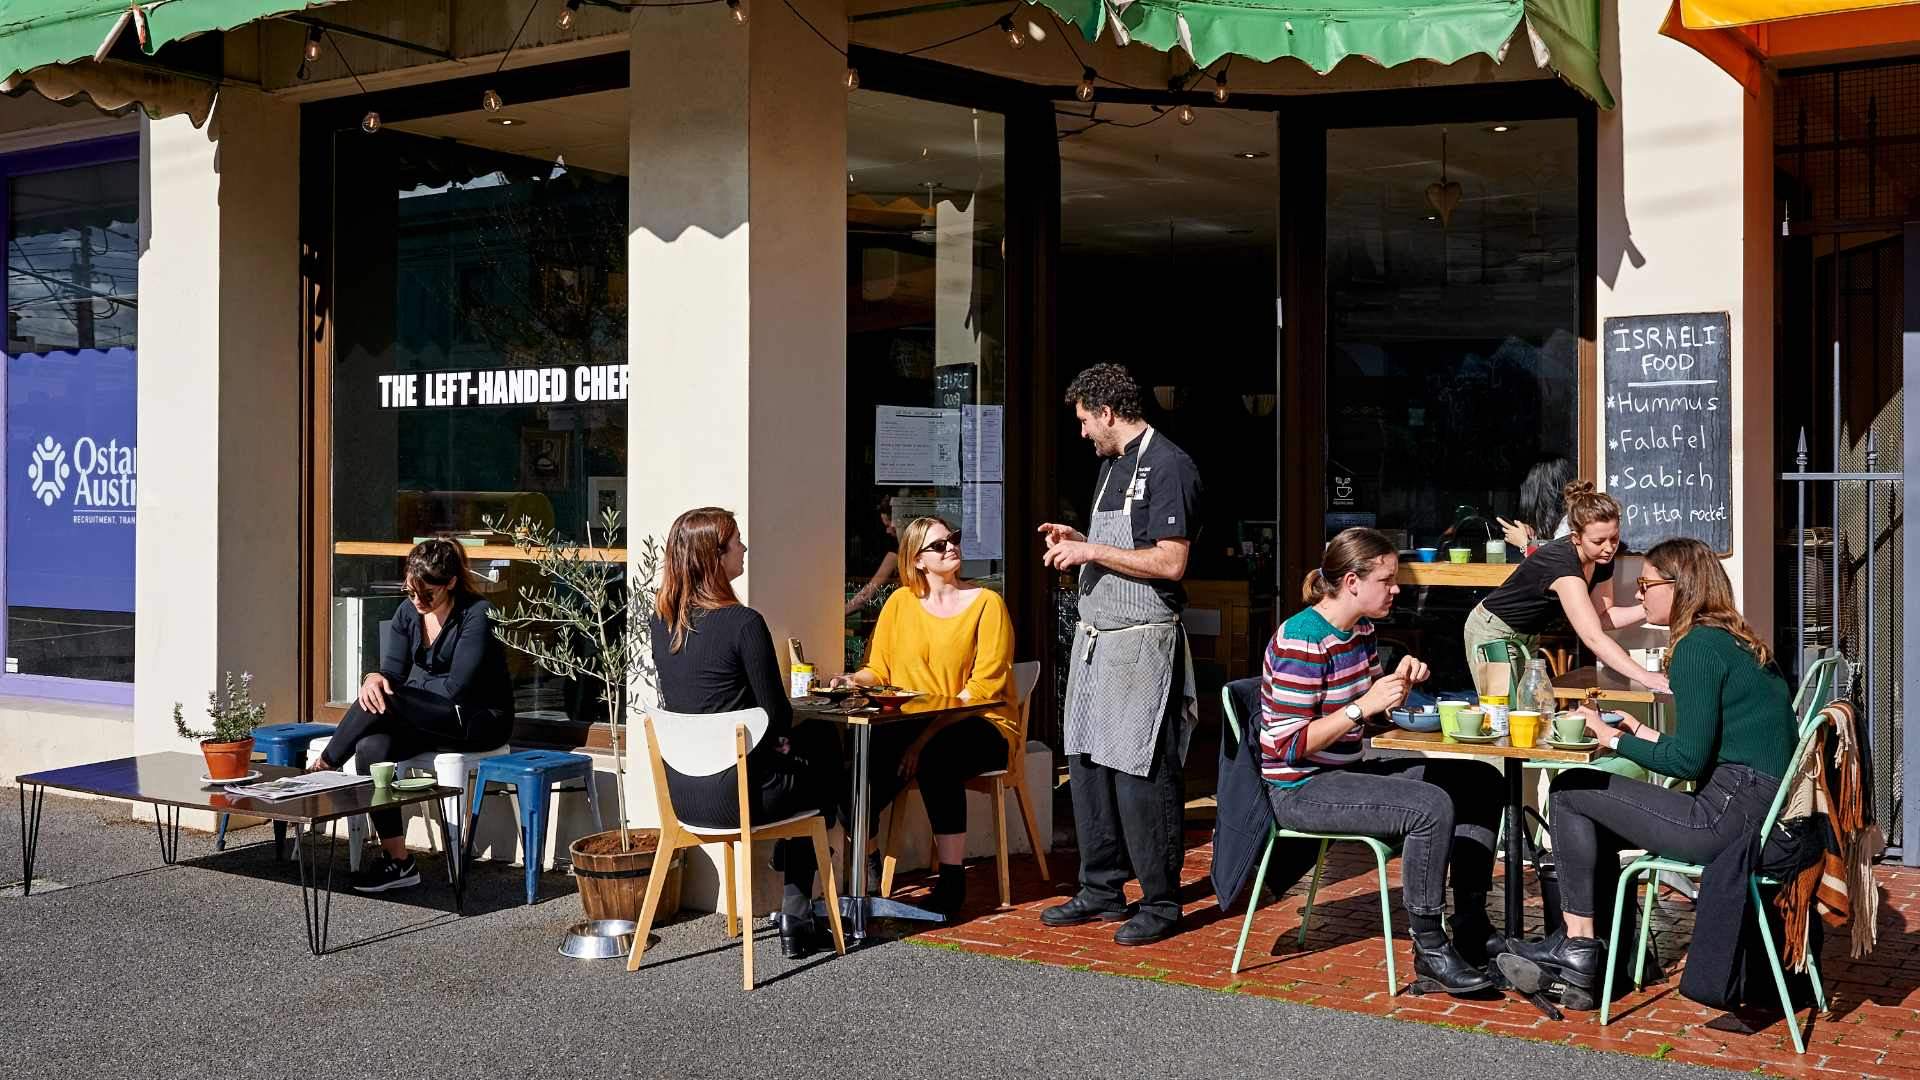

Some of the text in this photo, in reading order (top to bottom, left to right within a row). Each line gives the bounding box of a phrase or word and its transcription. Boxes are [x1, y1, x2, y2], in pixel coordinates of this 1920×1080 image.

[1613, 325, 1717, 352] ISRAELI
[1642, 353, 1695, 375] FOOD
[378, 374, 418, 408] THE
[425, 368, 567, 407] LEFT-HANDED
[1618, 392, 1719, 413] Hummus
[1620, 424, 1706, 453] Falafel
[1624, 462, 1713, 491] Sabich
[73, 515, 118, 525] RECRUITMENT,
[1626, 503, 1683, 525] Pitta
